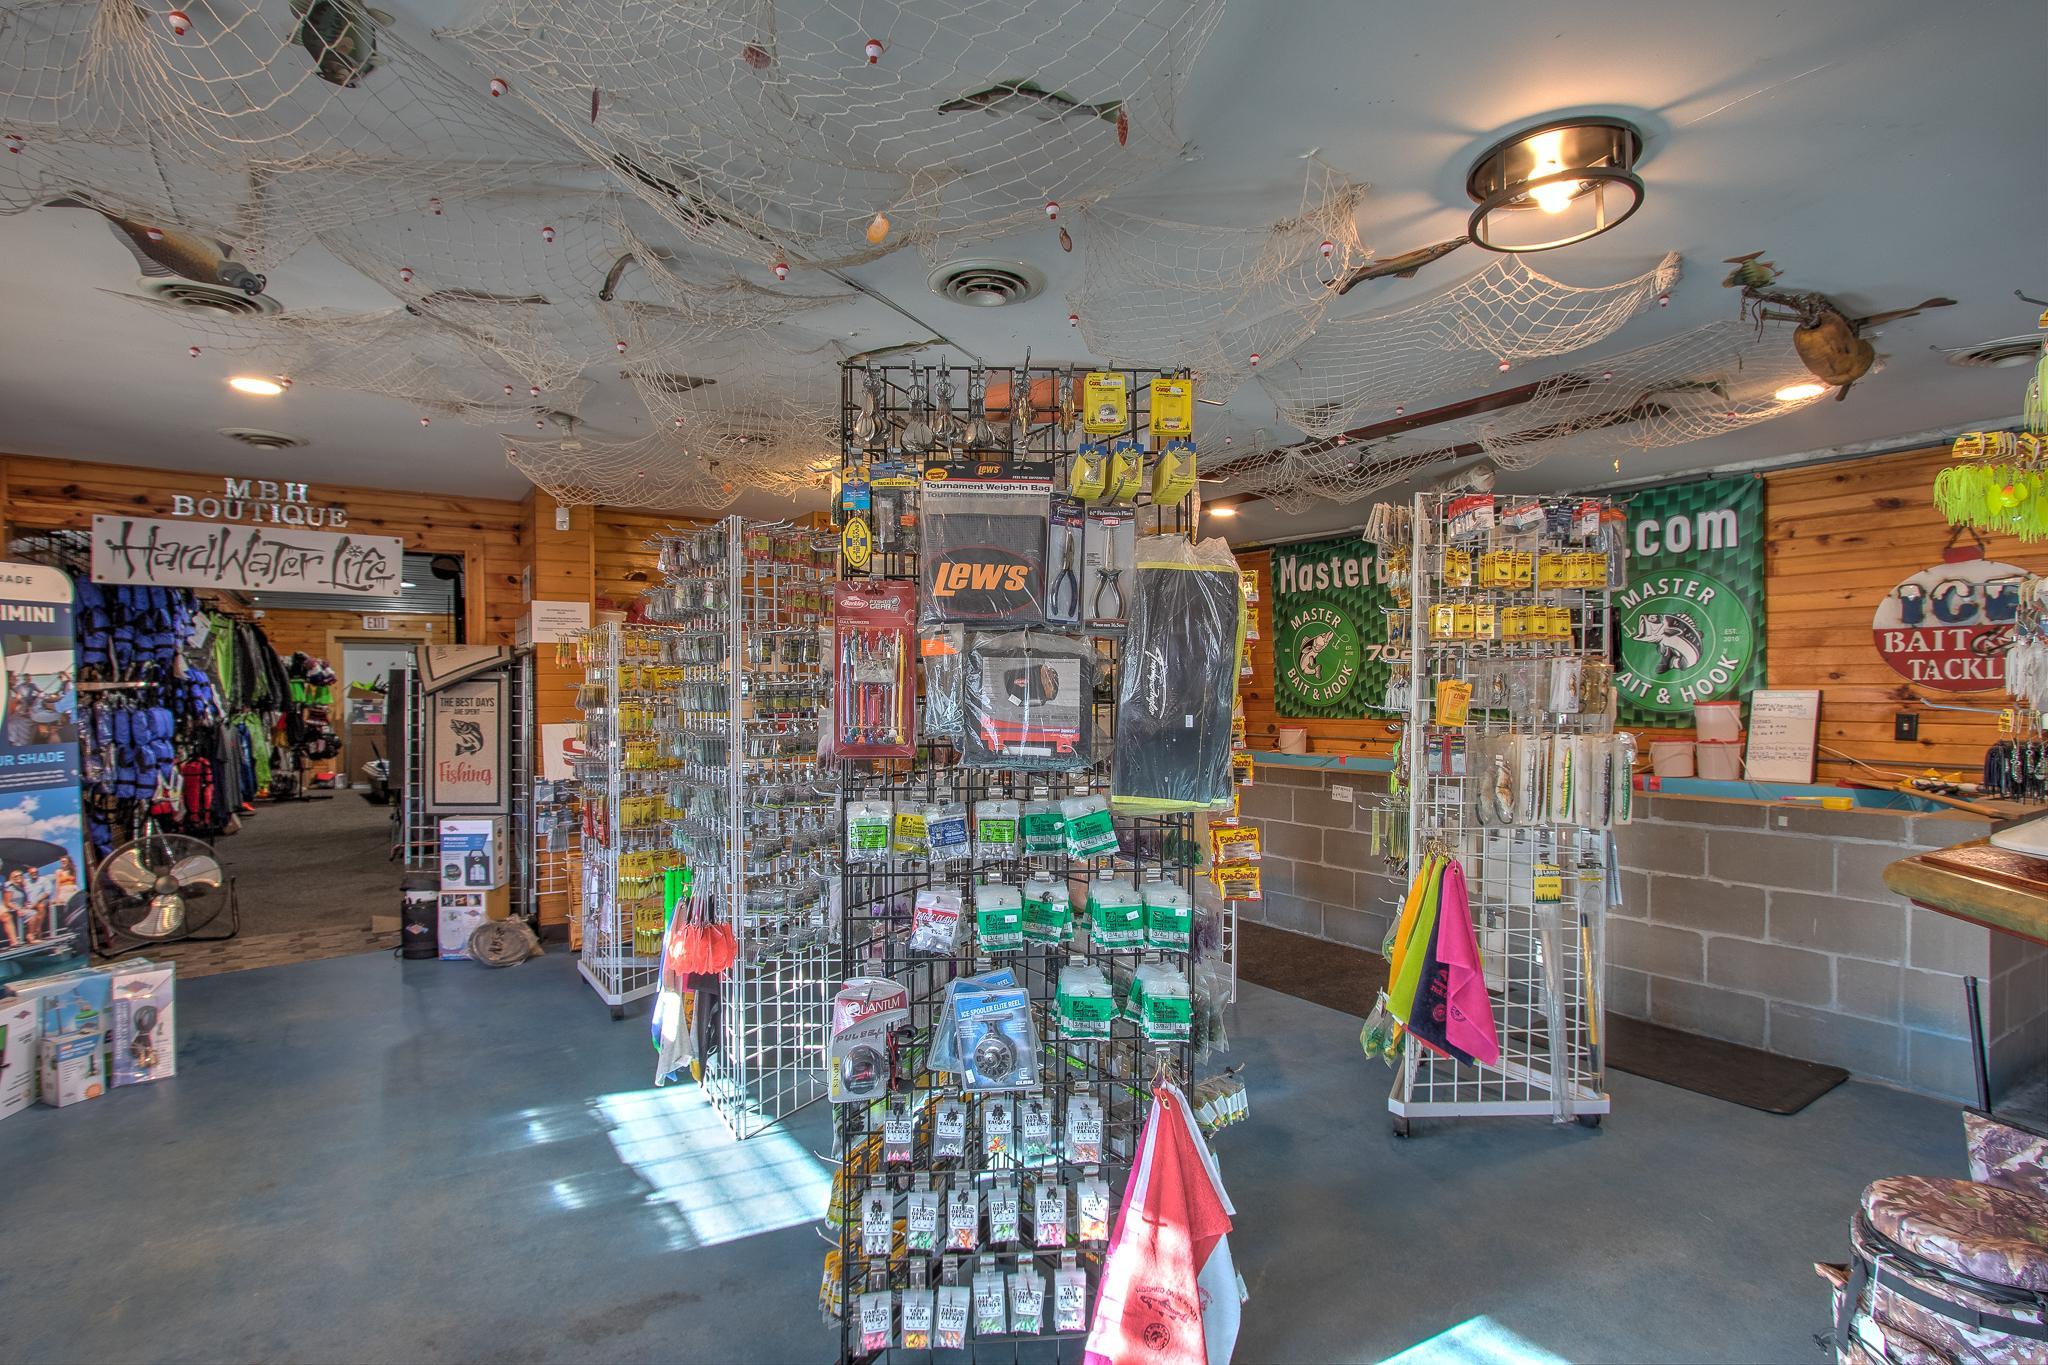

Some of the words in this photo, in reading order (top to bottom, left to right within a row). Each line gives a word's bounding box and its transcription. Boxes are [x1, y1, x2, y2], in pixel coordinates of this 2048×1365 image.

[223, 477, 309, 504] MBH
[925, 481, 984, 491] Tournament
[985, 482, 1028, 492] Weigh-In
[1030, 484, 1050, 492] Bag
[171, 494, 349, 528] BOUTIQUE
[843, 600, 866, 608] Berkley
[1620, 577, 1717, 610] MASTER
[1898, 574, 2027, 625] ICE
[0, 604, 56, 623] IMINI
[367, 617, 386, 629] EXIT
[1290, 607, 1342, 631] MASTER
[1883, 628, 1973, 653] BAIT
[1616, 672, 1653, 698] AIT
[1656, 687, 1672, 704] &
[1680, 653, 1740, 703] HOOK
[1907, 657, 2008, 681] TACKL
[1287, 667, 1310, 696] BAIT
[1312, 688, 1321, 701] &
[1324, 664, 1353, 700] HOOK
[439, 697, 454, 707] THE
[456, 697, 474, 707] BEST
[475, 697, 495, 707] DAYS
[17, 751, 65, 765] SHADE
[438, 760, 492, 786] Fishing
[1219, 832, 1257, 843] Eye-Candy
[1220, 871, 1257, 881] Eye-Candy
[915, 911, 937, 921] EAGLE
[935, 914, 956, 925] CLAW
[845, 995, 901, 1017] QUANTUM
[960, 1010, 970, 1018] ICE
[970, 1005, 994, 1016] SPOOLER
[993, 1002, 1008, 1011] ELITE
[1007, 999, 1021, 1009] REEL
